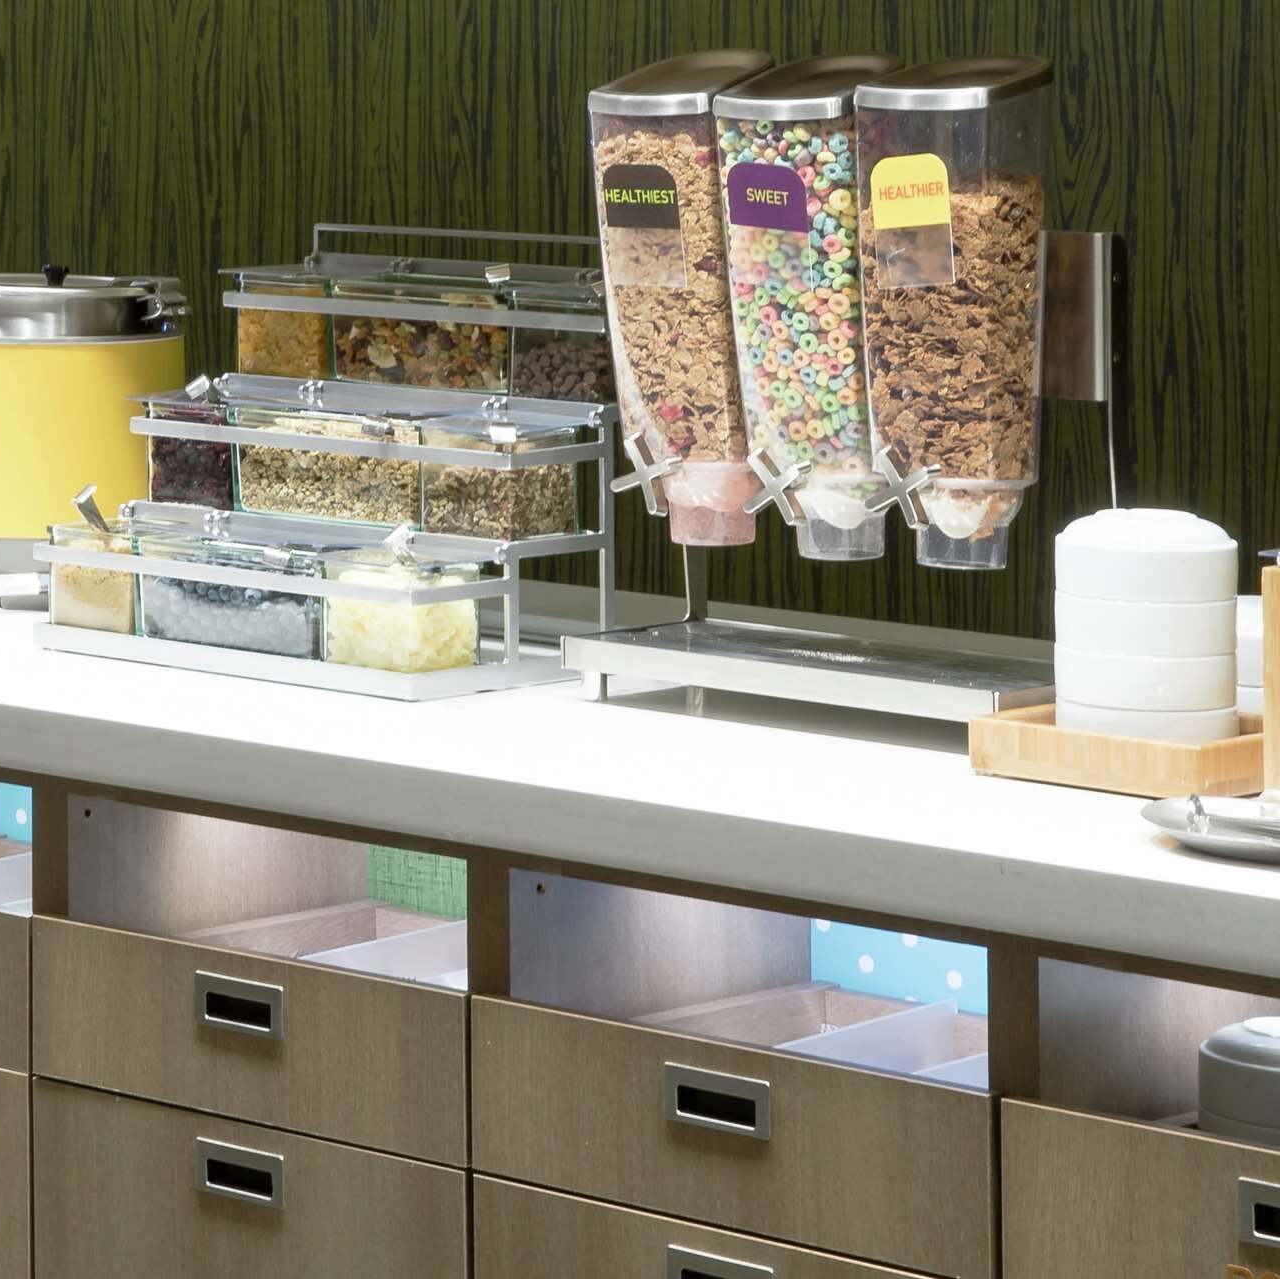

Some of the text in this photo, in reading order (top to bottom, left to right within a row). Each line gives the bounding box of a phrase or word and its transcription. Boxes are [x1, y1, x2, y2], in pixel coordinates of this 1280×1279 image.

[605, 187, 676, 205] HEALTHIEST
[746, 187, 790, 207] SWEET
[879, 181, 945, 202] HEALTHIER
